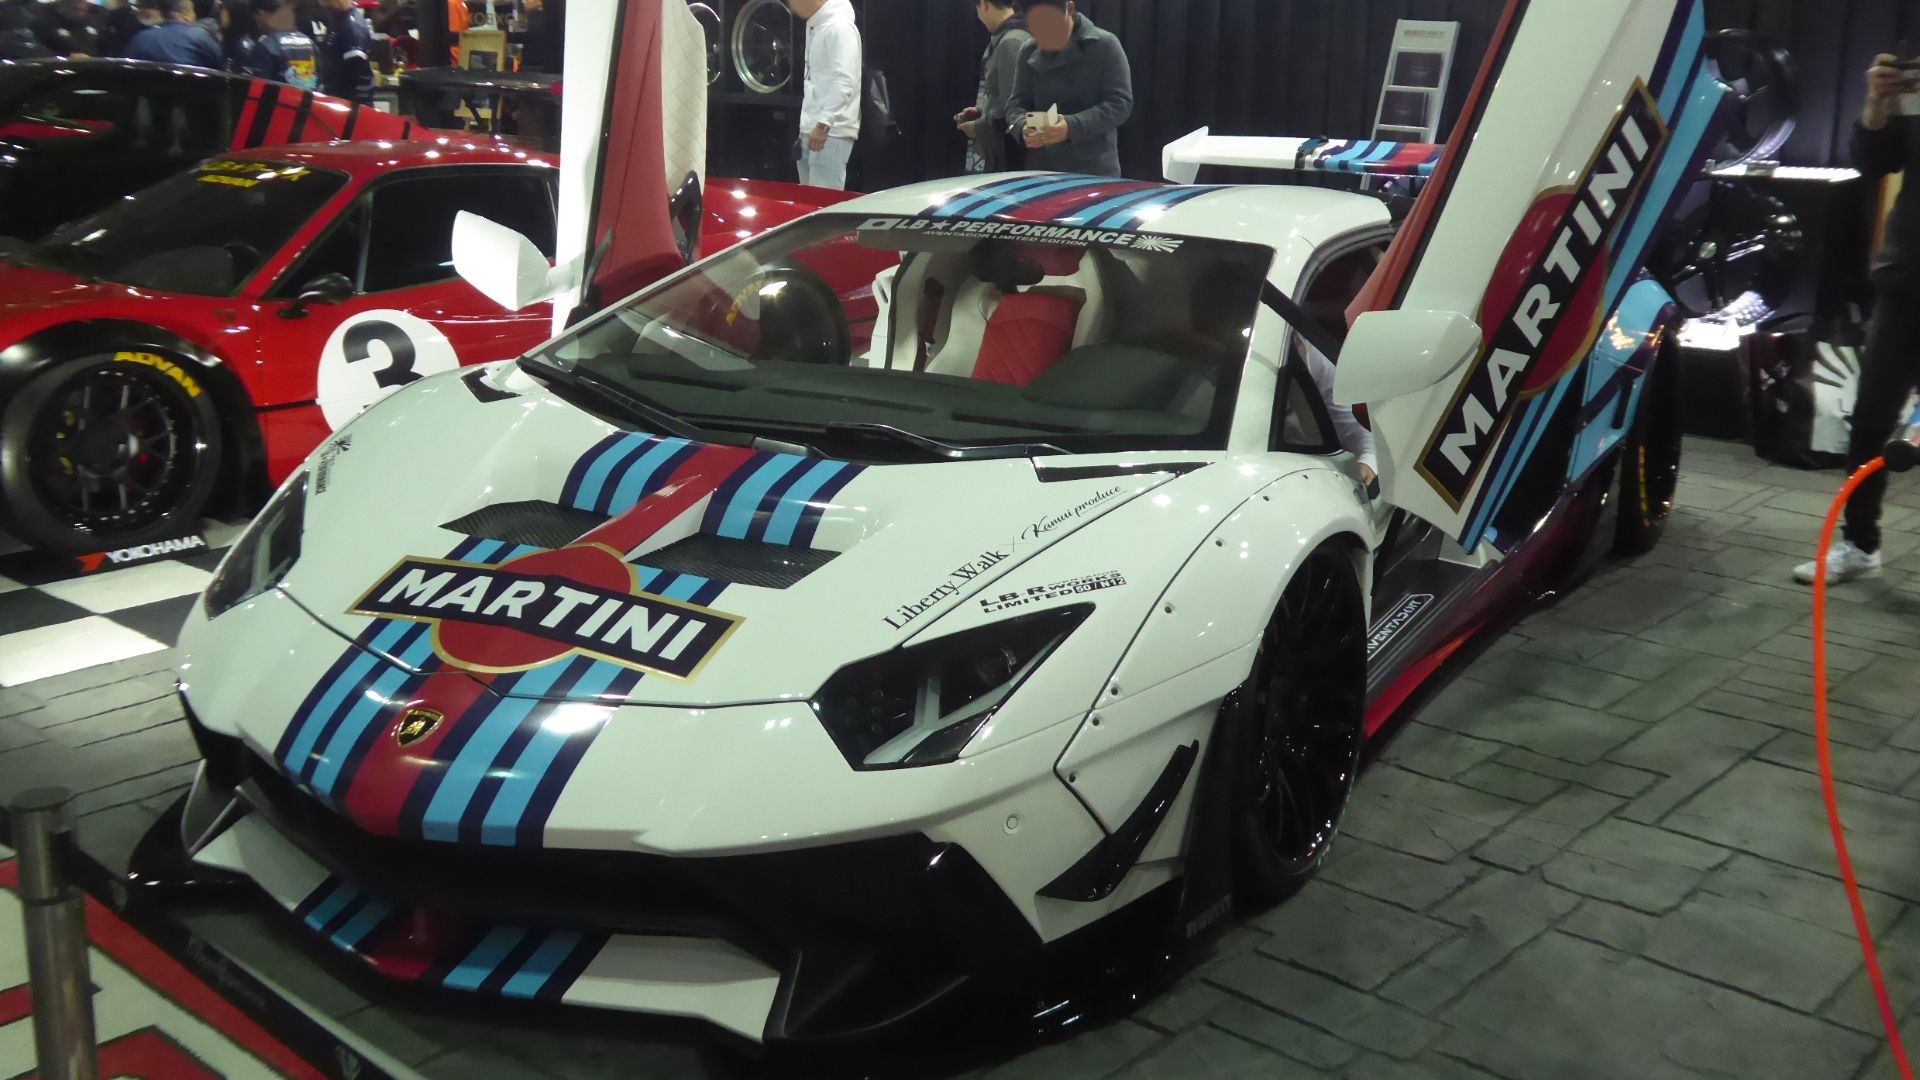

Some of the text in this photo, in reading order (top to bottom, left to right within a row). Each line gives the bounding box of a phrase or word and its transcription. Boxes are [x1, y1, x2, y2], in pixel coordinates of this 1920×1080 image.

[895, 218, 1136, 246] LB PERFORMANCE
[922, 230, 1089, 247] AVENTADOR LIMITED EDITION
[1439, 115, 1648, 476] MARTINI
[112, 351, 203, 398] ADVAN
[342, 319, 425, 389] 3
[1021, 486, 1121, 540] Kamui produce
[105, 534, 206, 564] YOKOHAMA
[377, 568, 707, 662] MARTINI
[881, 549, 1010, 631] Liberty Walk
[983, 588, 1074, 614] LIMITED
